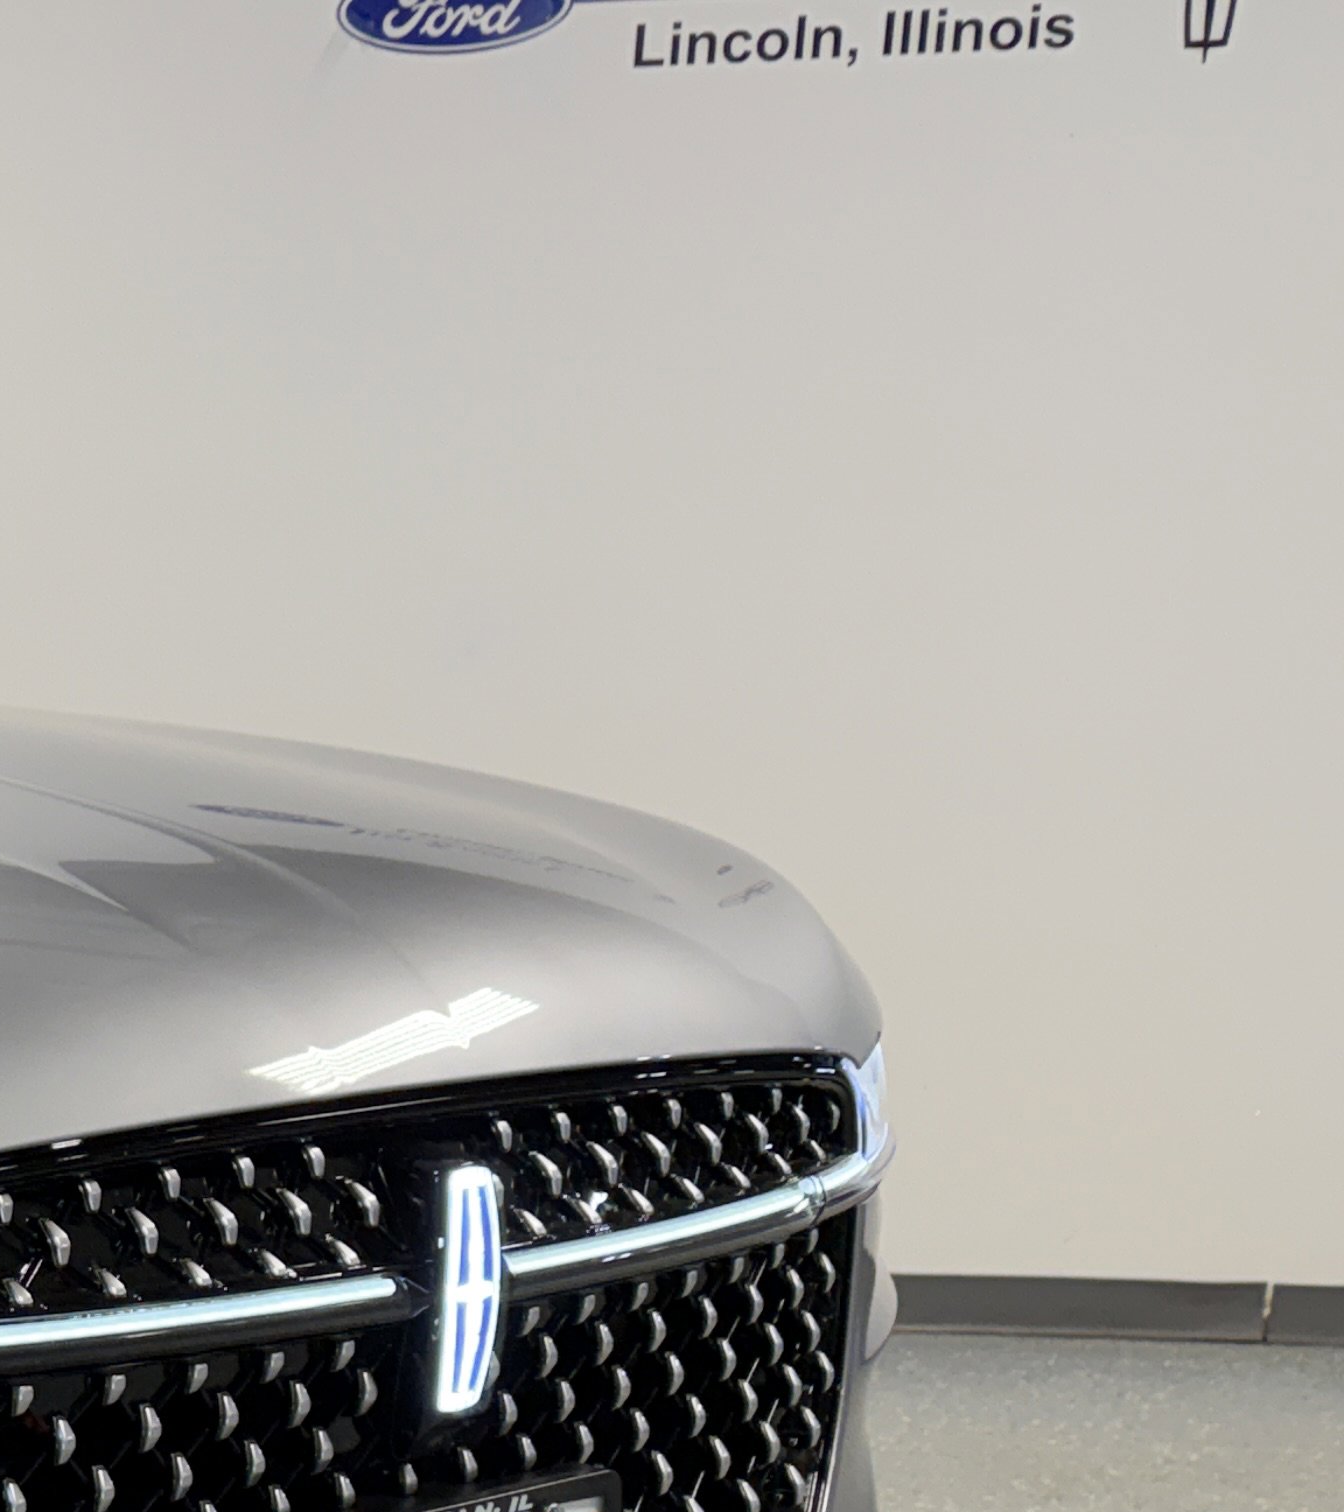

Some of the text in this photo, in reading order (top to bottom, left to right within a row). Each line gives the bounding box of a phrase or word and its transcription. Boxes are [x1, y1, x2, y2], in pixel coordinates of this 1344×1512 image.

[633, 3, 1075, 68] Lincoln, Illinois
[508, 1494, 533, 1512] IL
